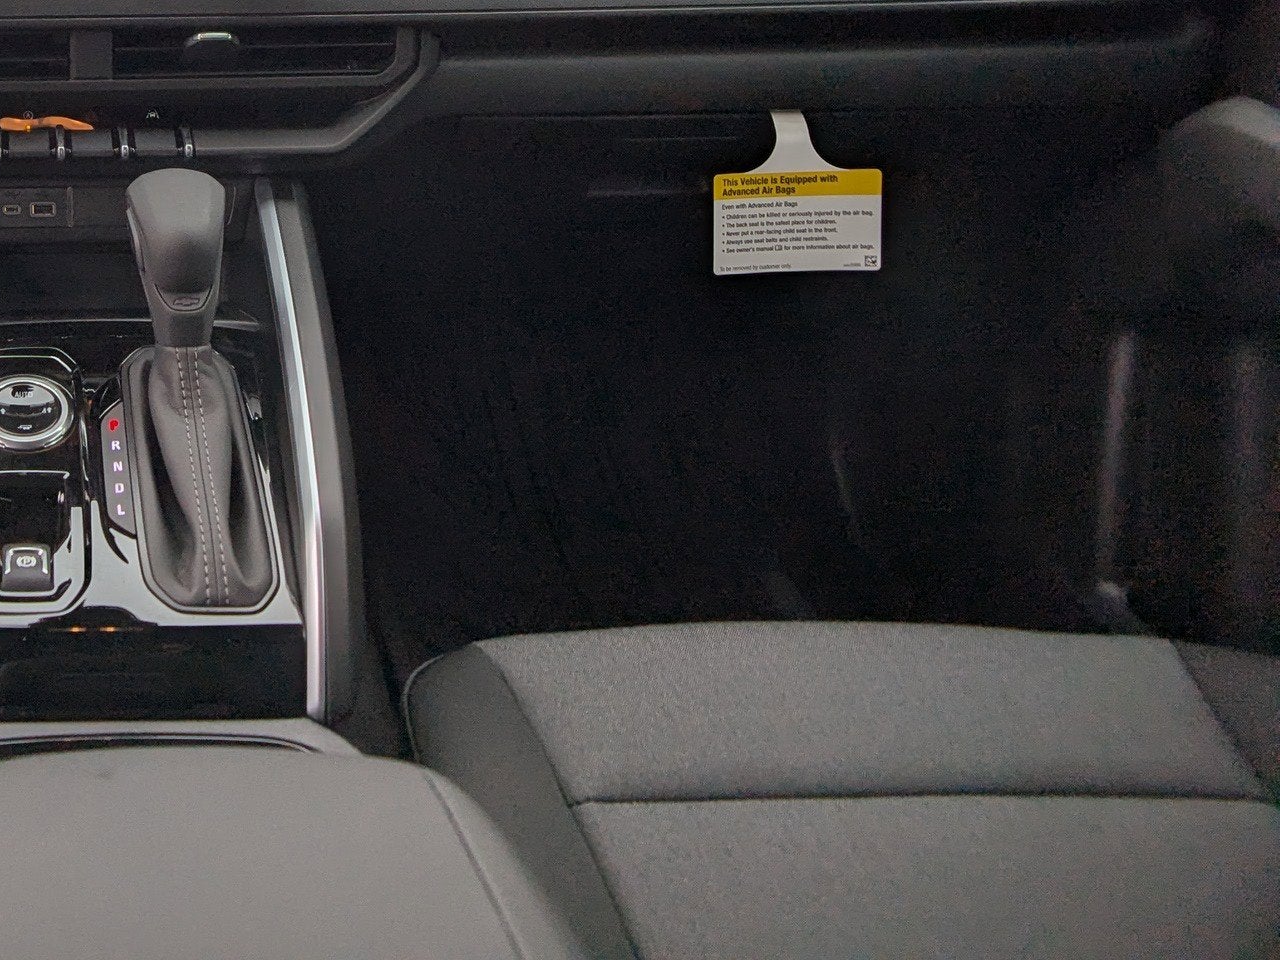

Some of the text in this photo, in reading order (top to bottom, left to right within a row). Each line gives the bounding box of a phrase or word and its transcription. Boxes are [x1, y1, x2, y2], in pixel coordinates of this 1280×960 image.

[740, 177, 768, 186] Vehicle
[780, 175, 817, 185] Equipped
[722, 187, 760, 196] Advanced
[776, 186, 796, 195] Bags
[110, 420, 118, 430] P
[112, 440, 120, 450] R
[113, 461, 122, 471] N
[115, 483, 124, 493] D
[117, 504, 125, 515] L
